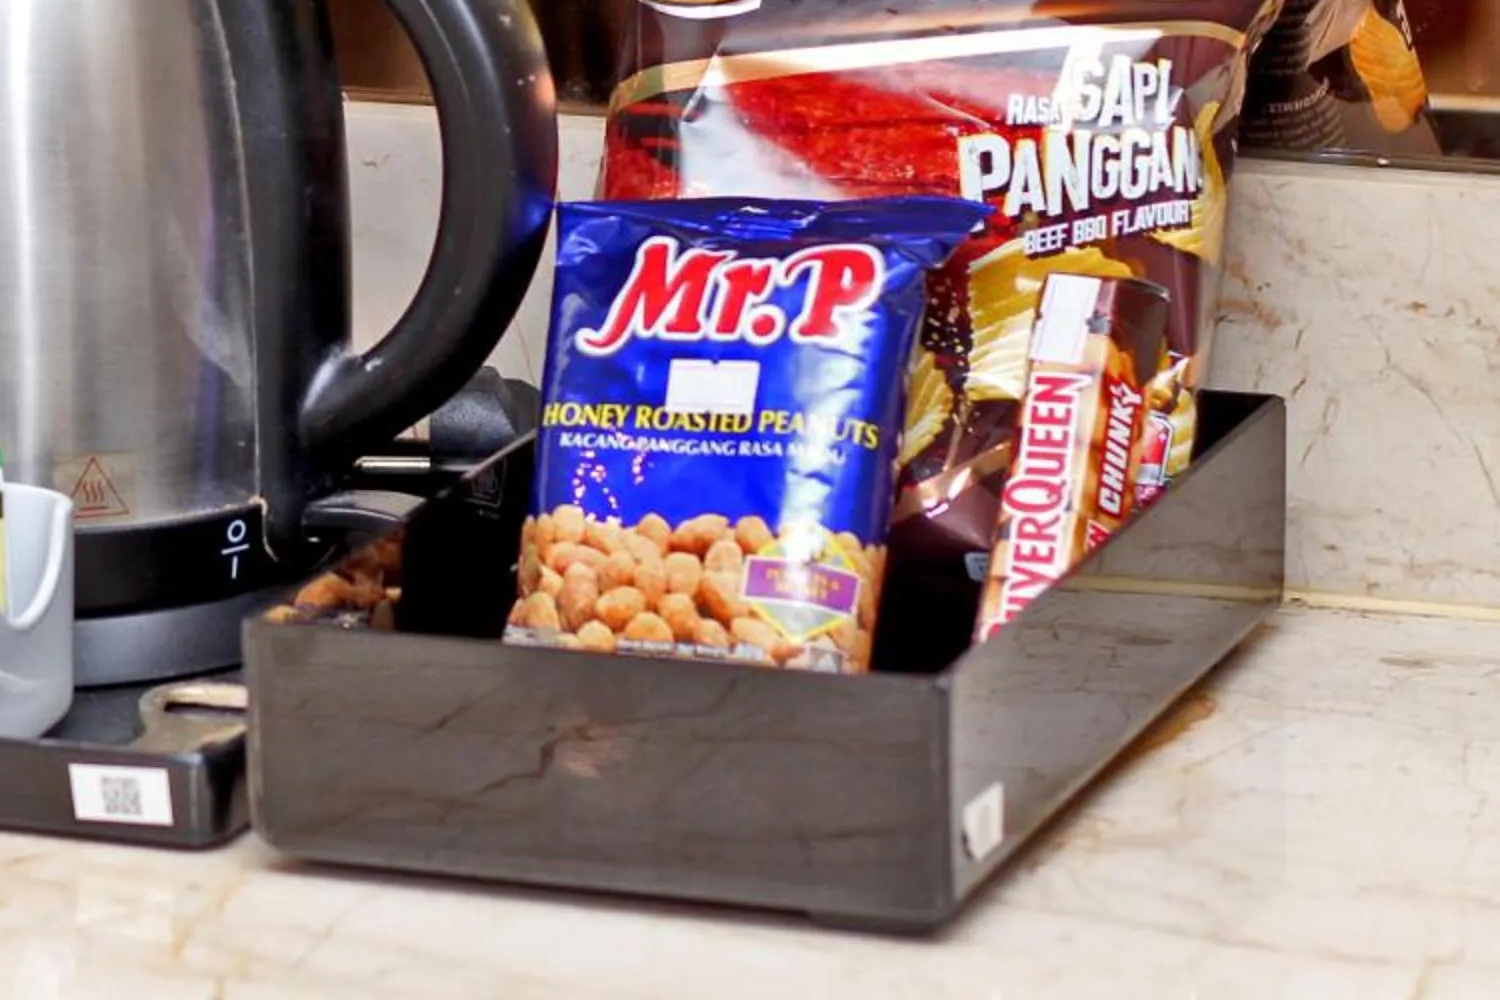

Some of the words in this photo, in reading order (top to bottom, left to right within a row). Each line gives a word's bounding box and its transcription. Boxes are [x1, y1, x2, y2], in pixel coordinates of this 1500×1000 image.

[1069, 50, 1176, 127] SAPI
[958, 125, 1203, 232] PANGGAN
[1024, 223, 1069, 254] BEEF
[1112, 200, 1190, 233] FLAVOUR
[577, 237, 882, 353] Mr.P
[543, 402, 632, 428] HONEY
[635, 404, 752, 433] ROASTED
[560, 432, 634, 450] KACANG
[635, 436, 736, 456] PANGGANG
[739, 440, 784, 457] RASA
[1100, 382, 1143, 515] CHUNKY
